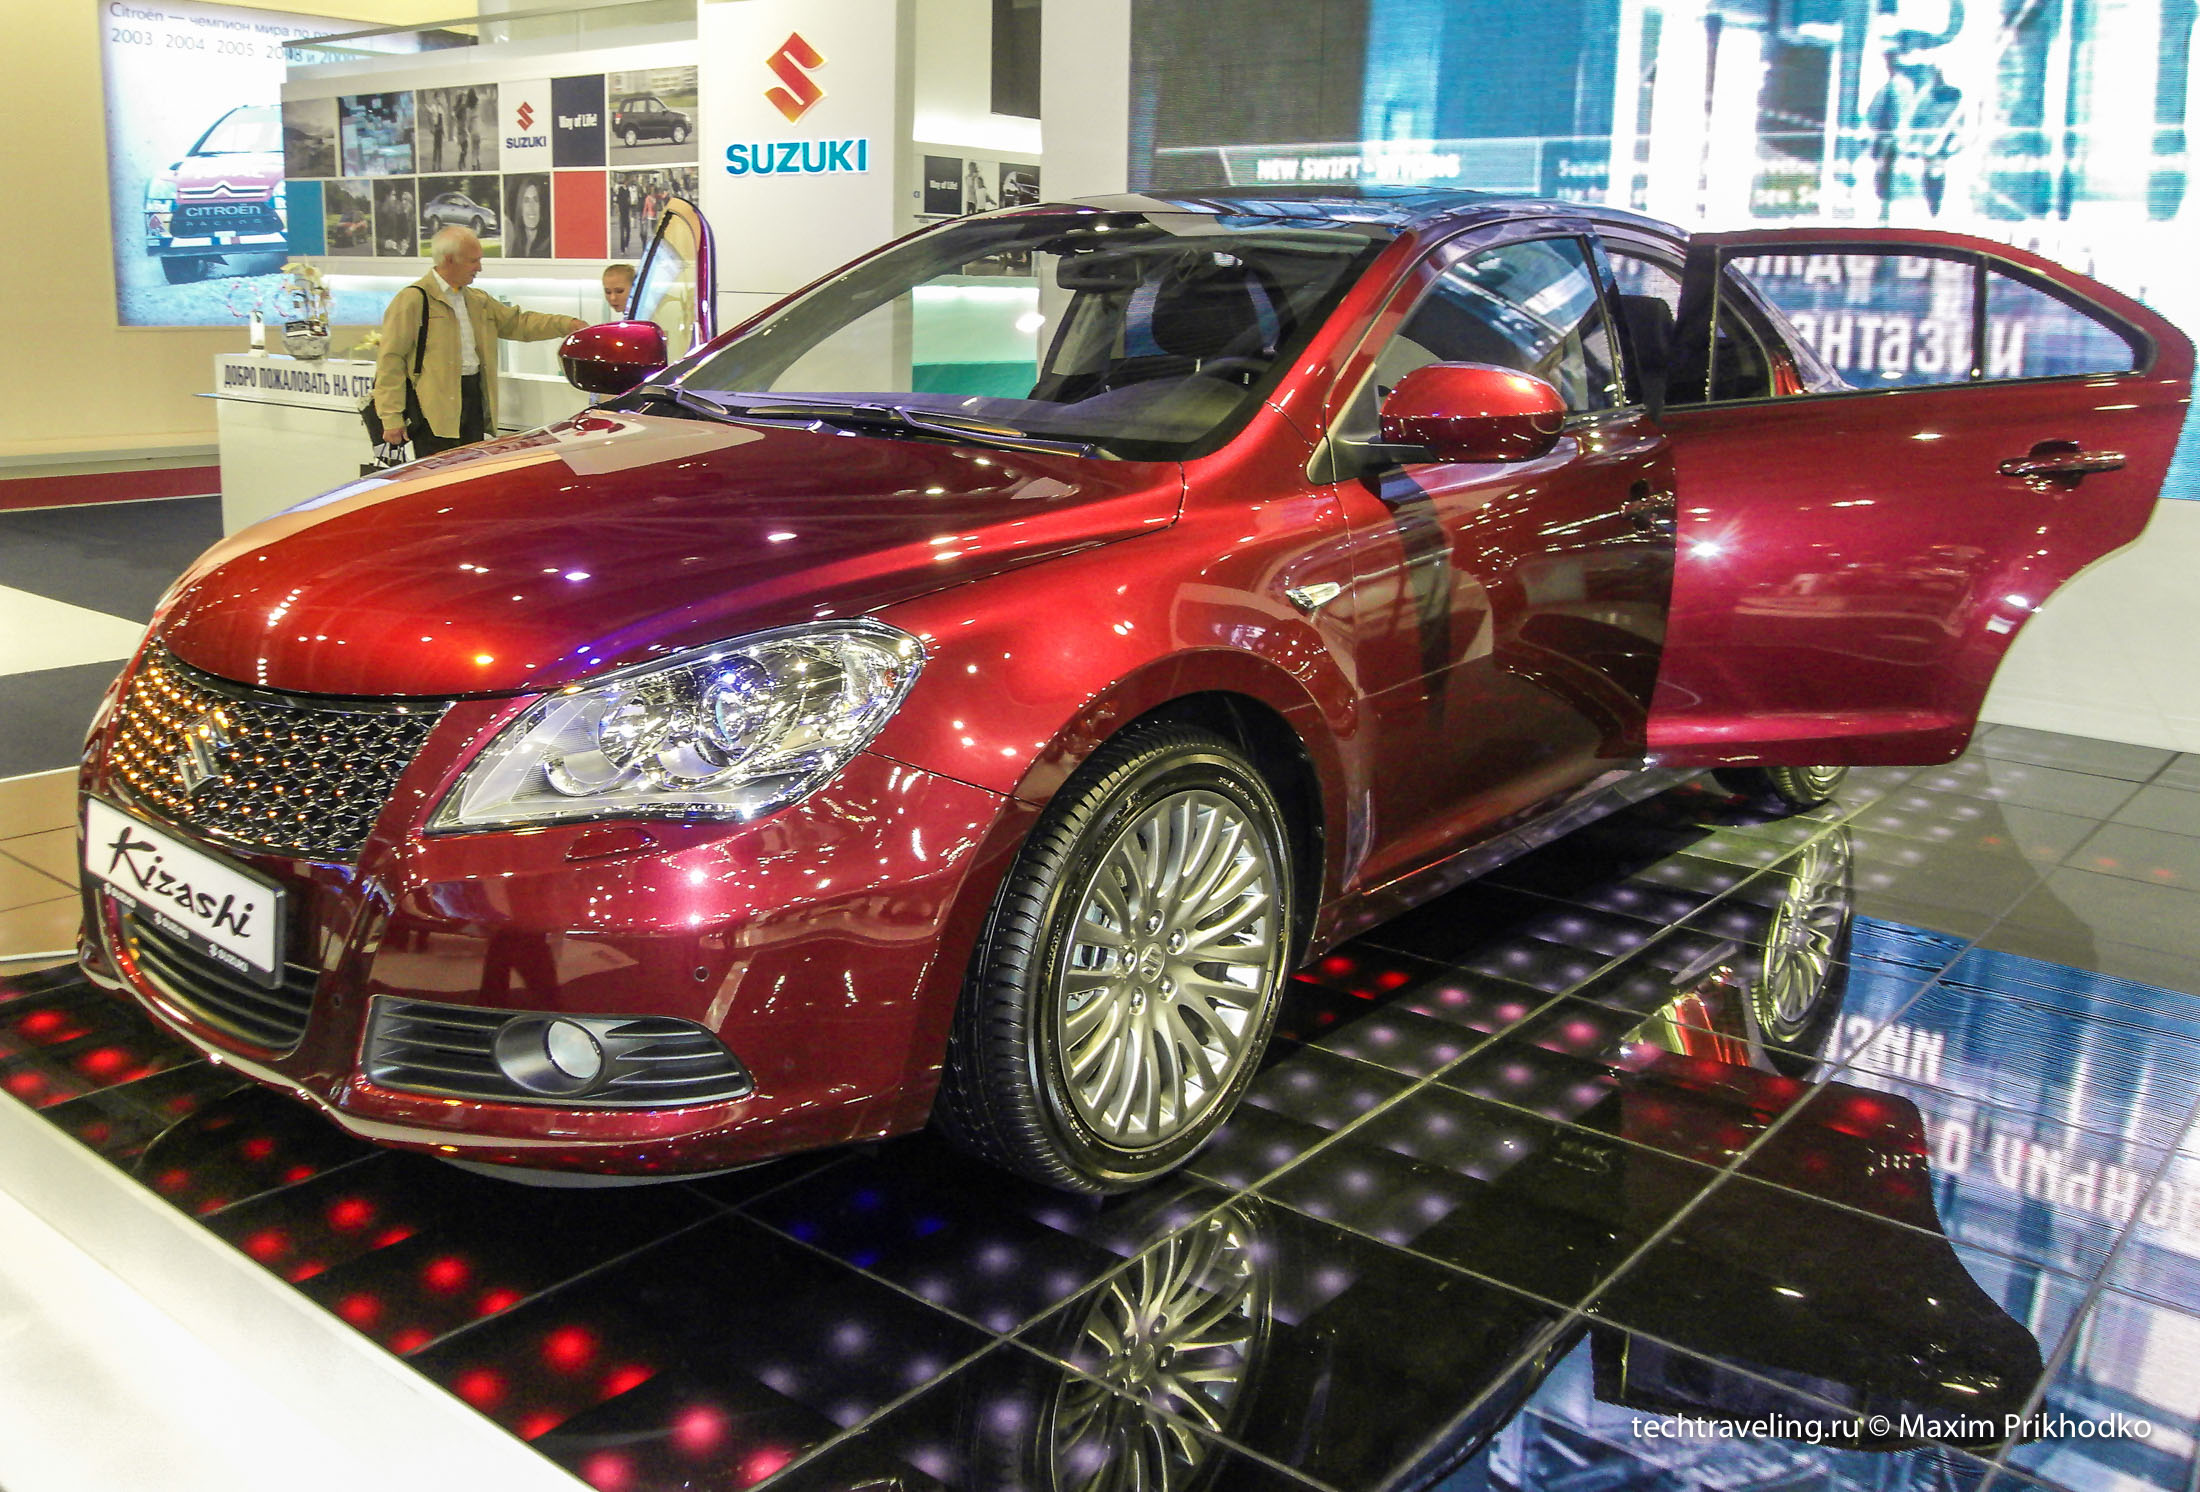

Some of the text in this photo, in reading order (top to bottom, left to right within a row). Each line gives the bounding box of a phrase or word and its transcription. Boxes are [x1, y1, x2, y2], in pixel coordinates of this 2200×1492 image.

[110, 2, 164, 22] Citroën
[190, 16, 251, 31] чемпион
[255, 23, 290, 37] мира
[112, 28, 153, 46] 2003
[166, 34, 205, 50] 2004
[217, 40, 255, 56] 2005
[506, 136, 547, 149] SUZUKI
[726, 139, 867, 175] SUZUKI
[224, 364, 257, 389] ДОБРО
[260, 367, 330, 395] ПОЖАЛОВАТЬ
[333, 374, 349, 397] НА
[108, 826, 254, 938] Kizashi
